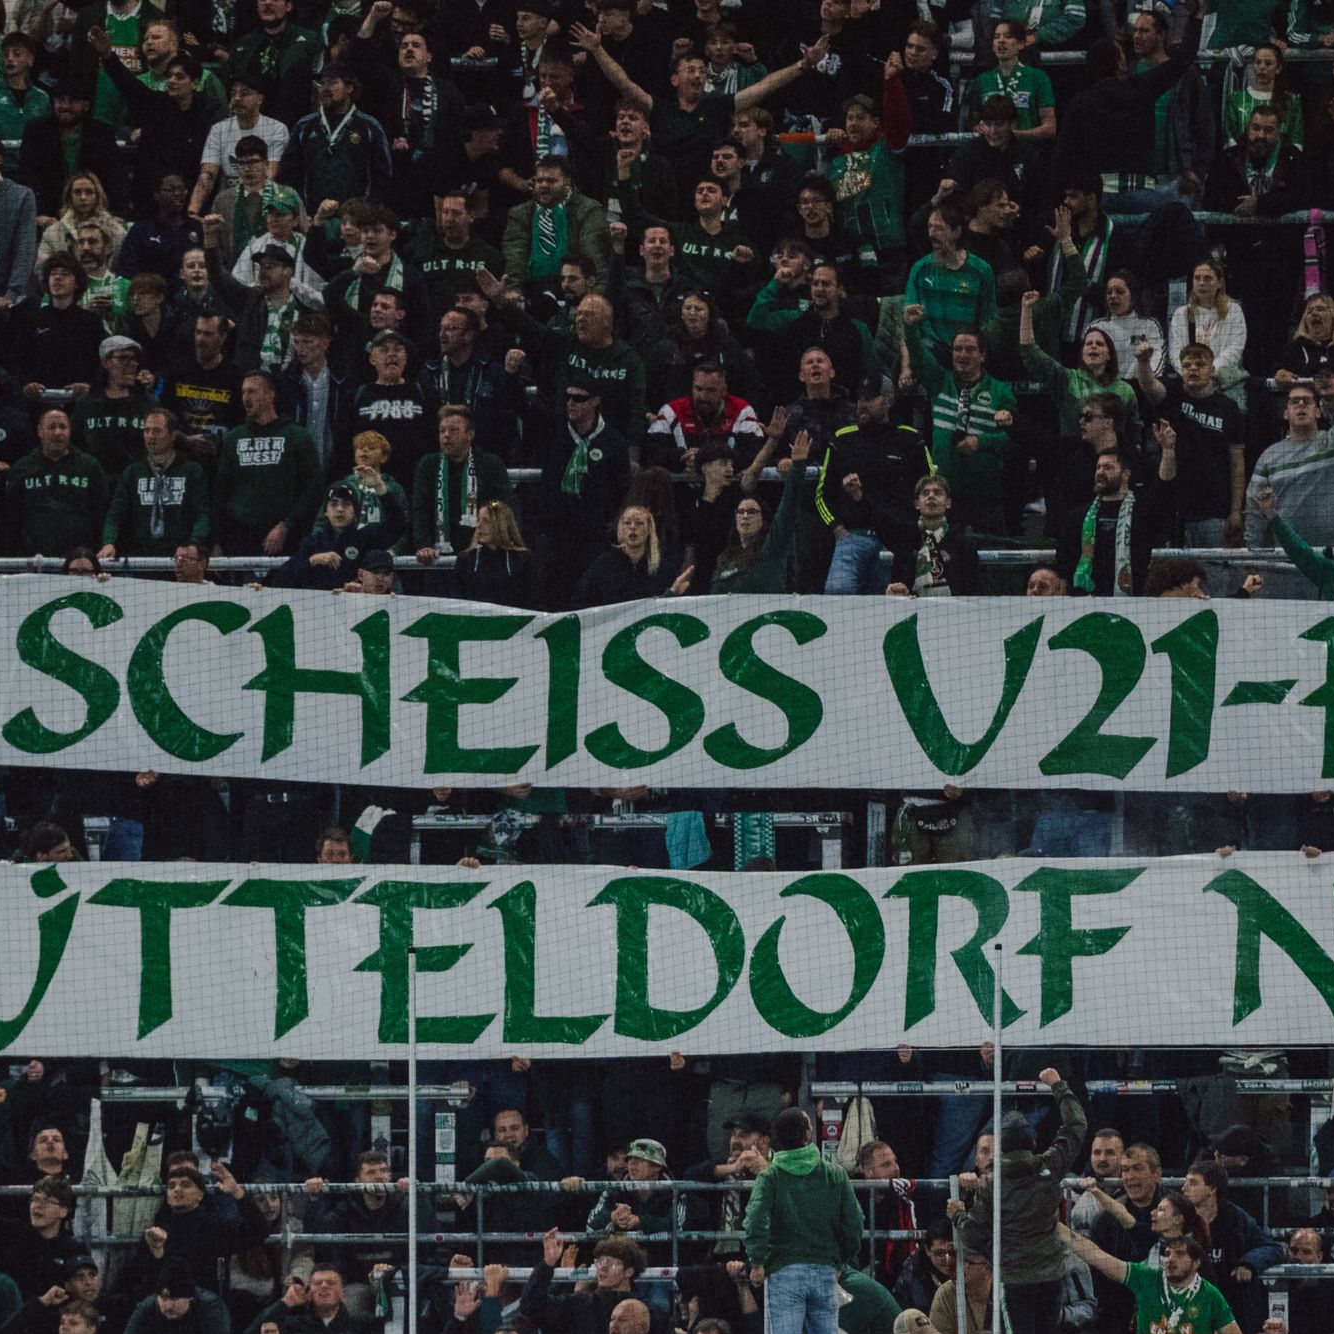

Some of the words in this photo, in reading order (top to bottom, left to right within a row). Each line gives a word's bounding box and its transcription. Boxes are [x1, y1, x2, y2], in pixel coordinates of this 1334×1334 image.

[237, 438, 285, 453] BLOCK
[239, 452, 281, 466] WEST
[25, 474, 89, 489] ULTRAS
[2, 592, 827, 774] SCHEISS
